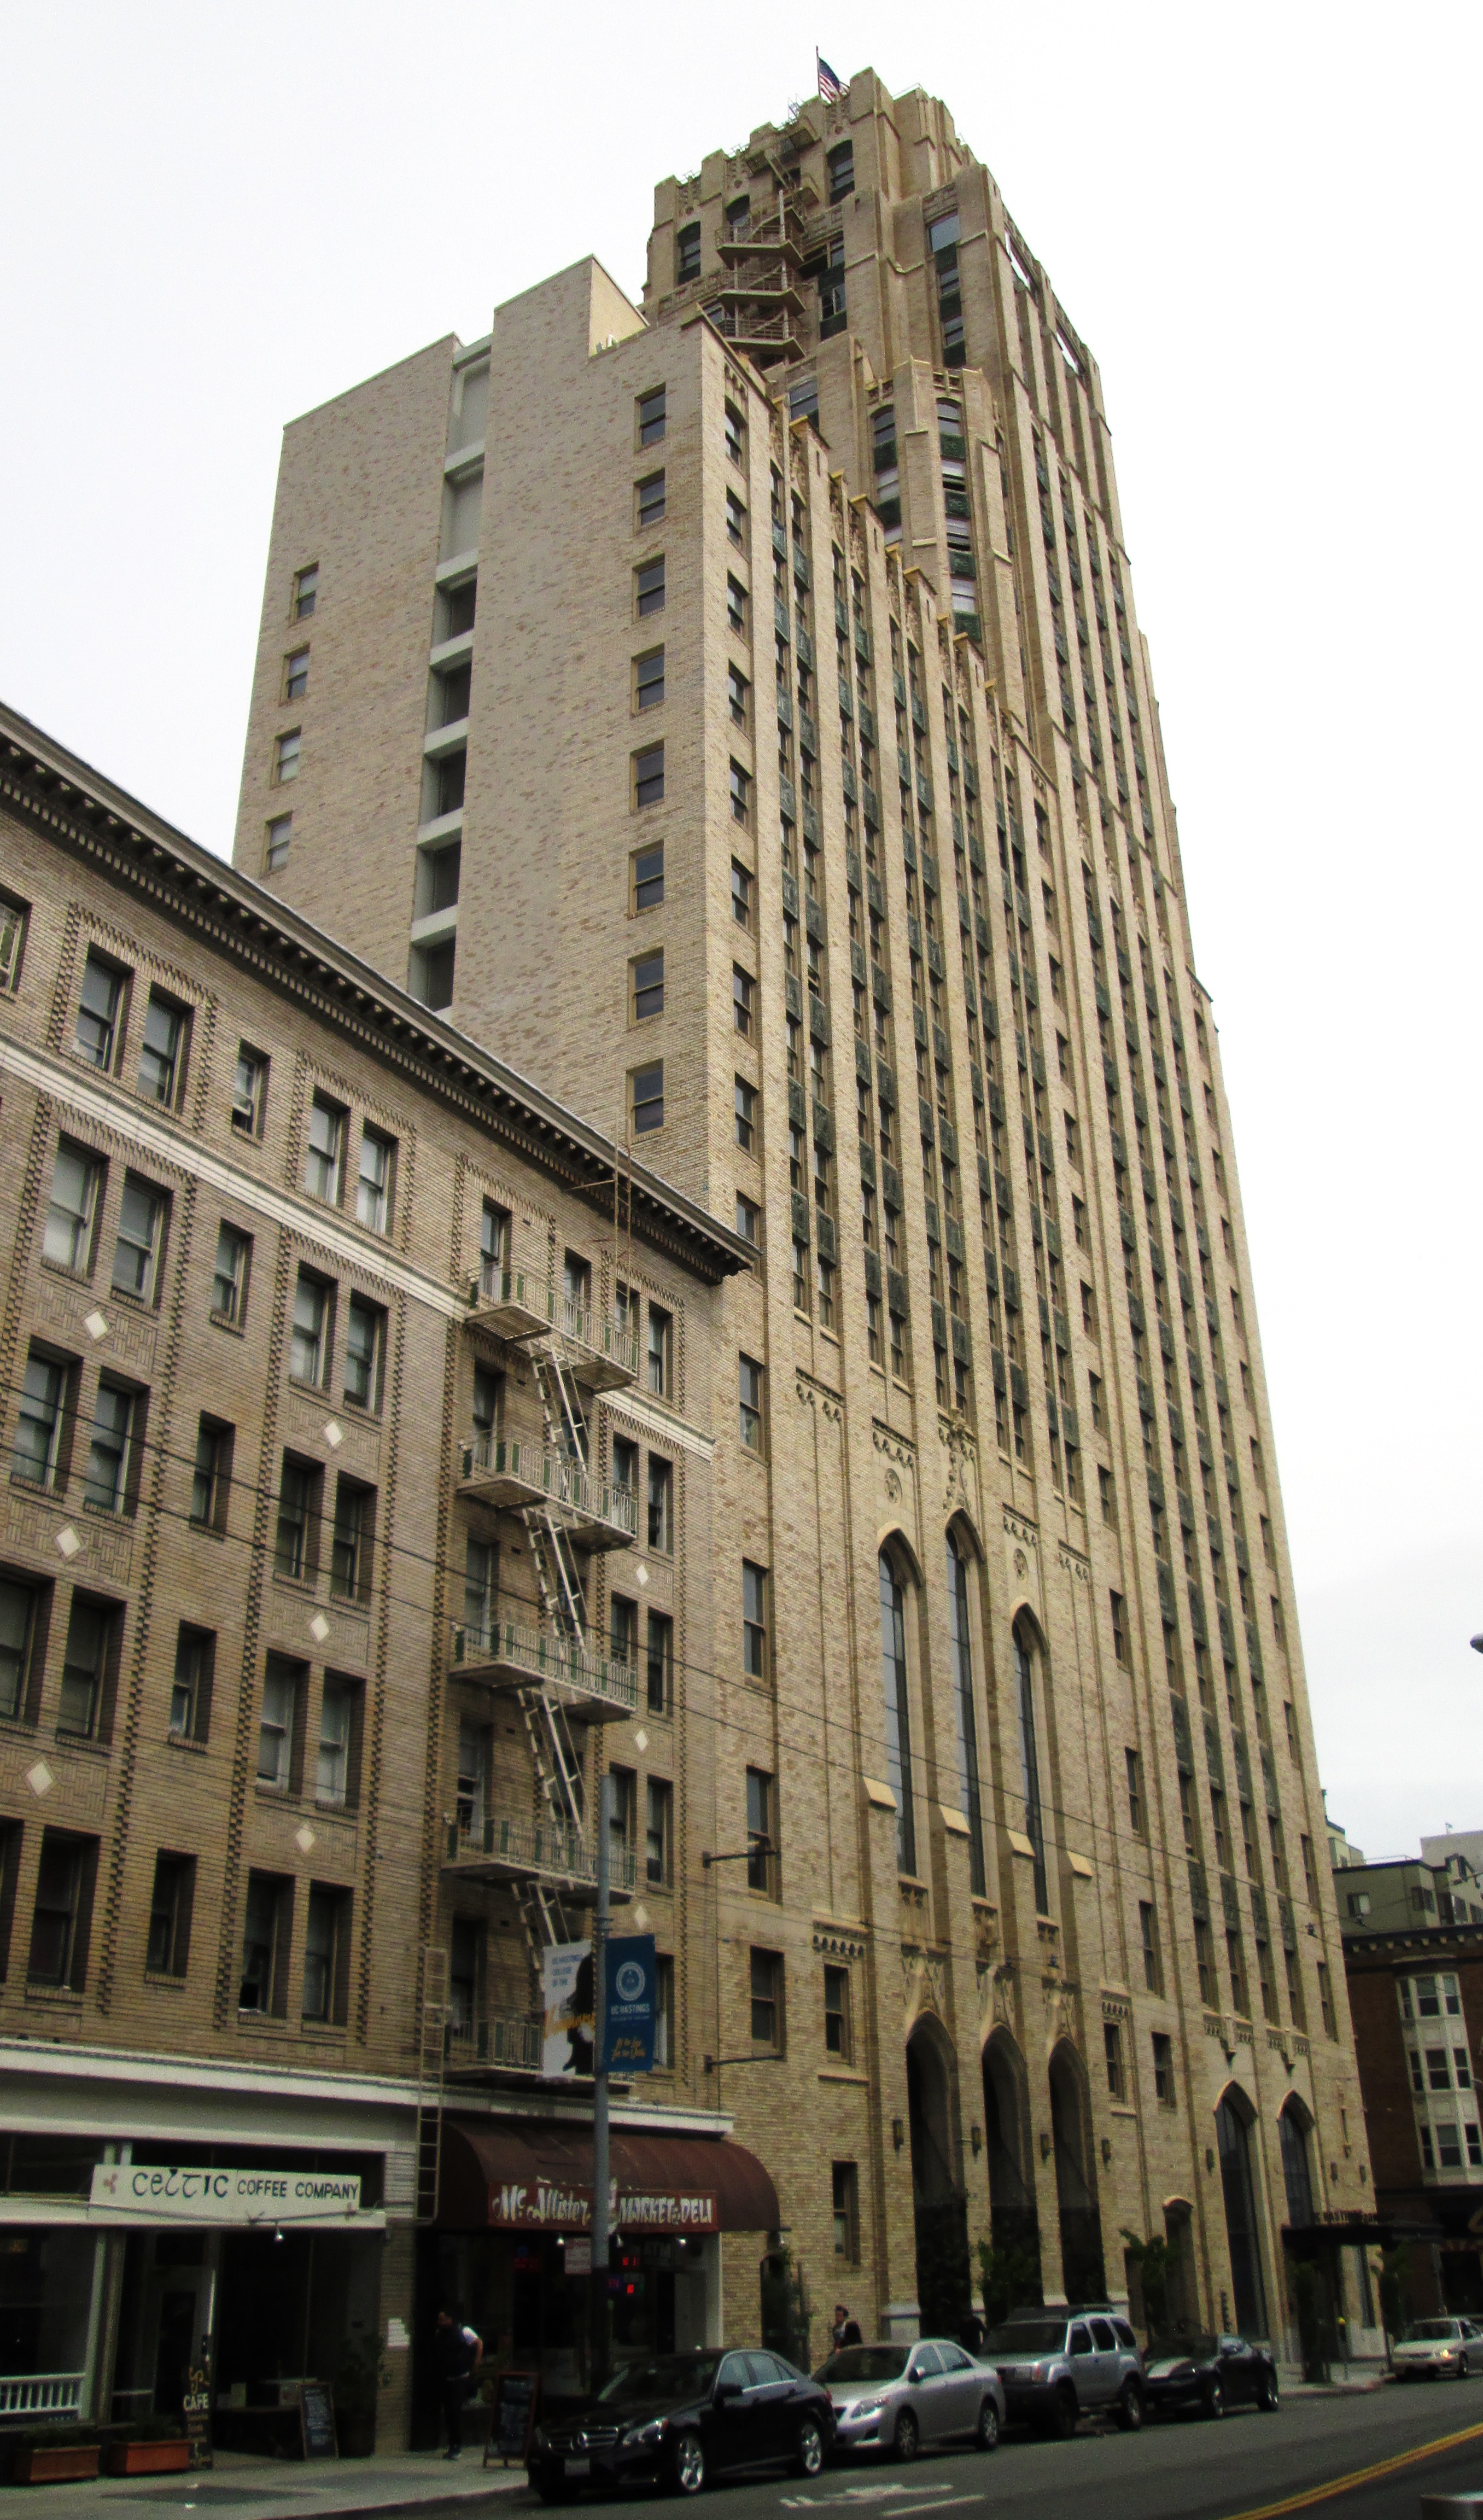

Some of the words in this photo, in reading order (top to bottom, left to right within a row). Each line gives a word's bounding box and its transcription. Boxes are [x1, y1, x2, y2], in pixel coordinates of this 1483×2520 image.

[237, 2179, 288, 2197] COFFEE
[295, 2181, 359, 2200] COMPANY
[619, 2197, 675, 2224] MARKET
[680, 2197, 712, 2224] DELI
[183, 2393, 209, 2411] CAFE
